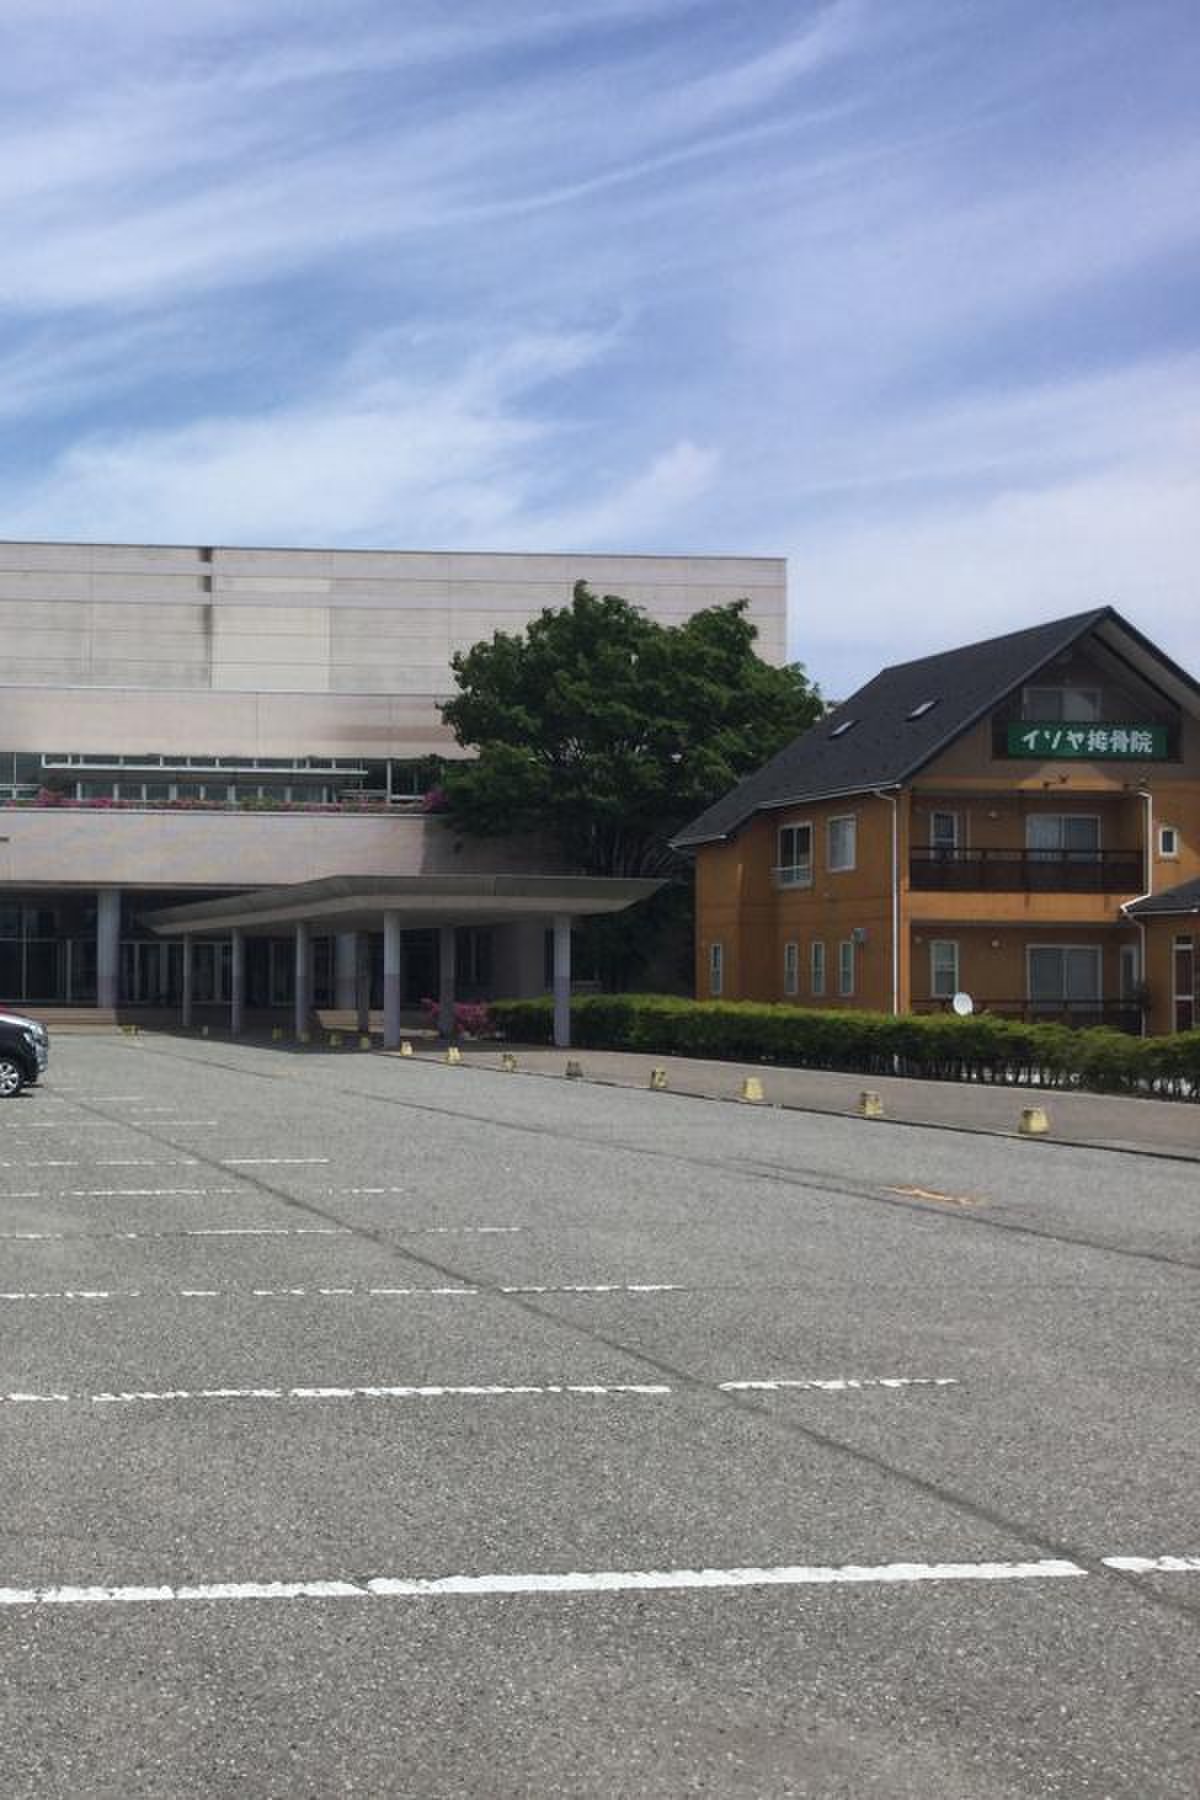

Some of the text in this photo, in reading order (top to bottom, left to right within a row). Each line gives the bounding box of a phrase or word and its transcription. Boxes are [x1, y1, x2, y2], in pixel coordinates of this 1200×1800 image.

[1022, 729, 1153, 753] イソヤ接骨院
